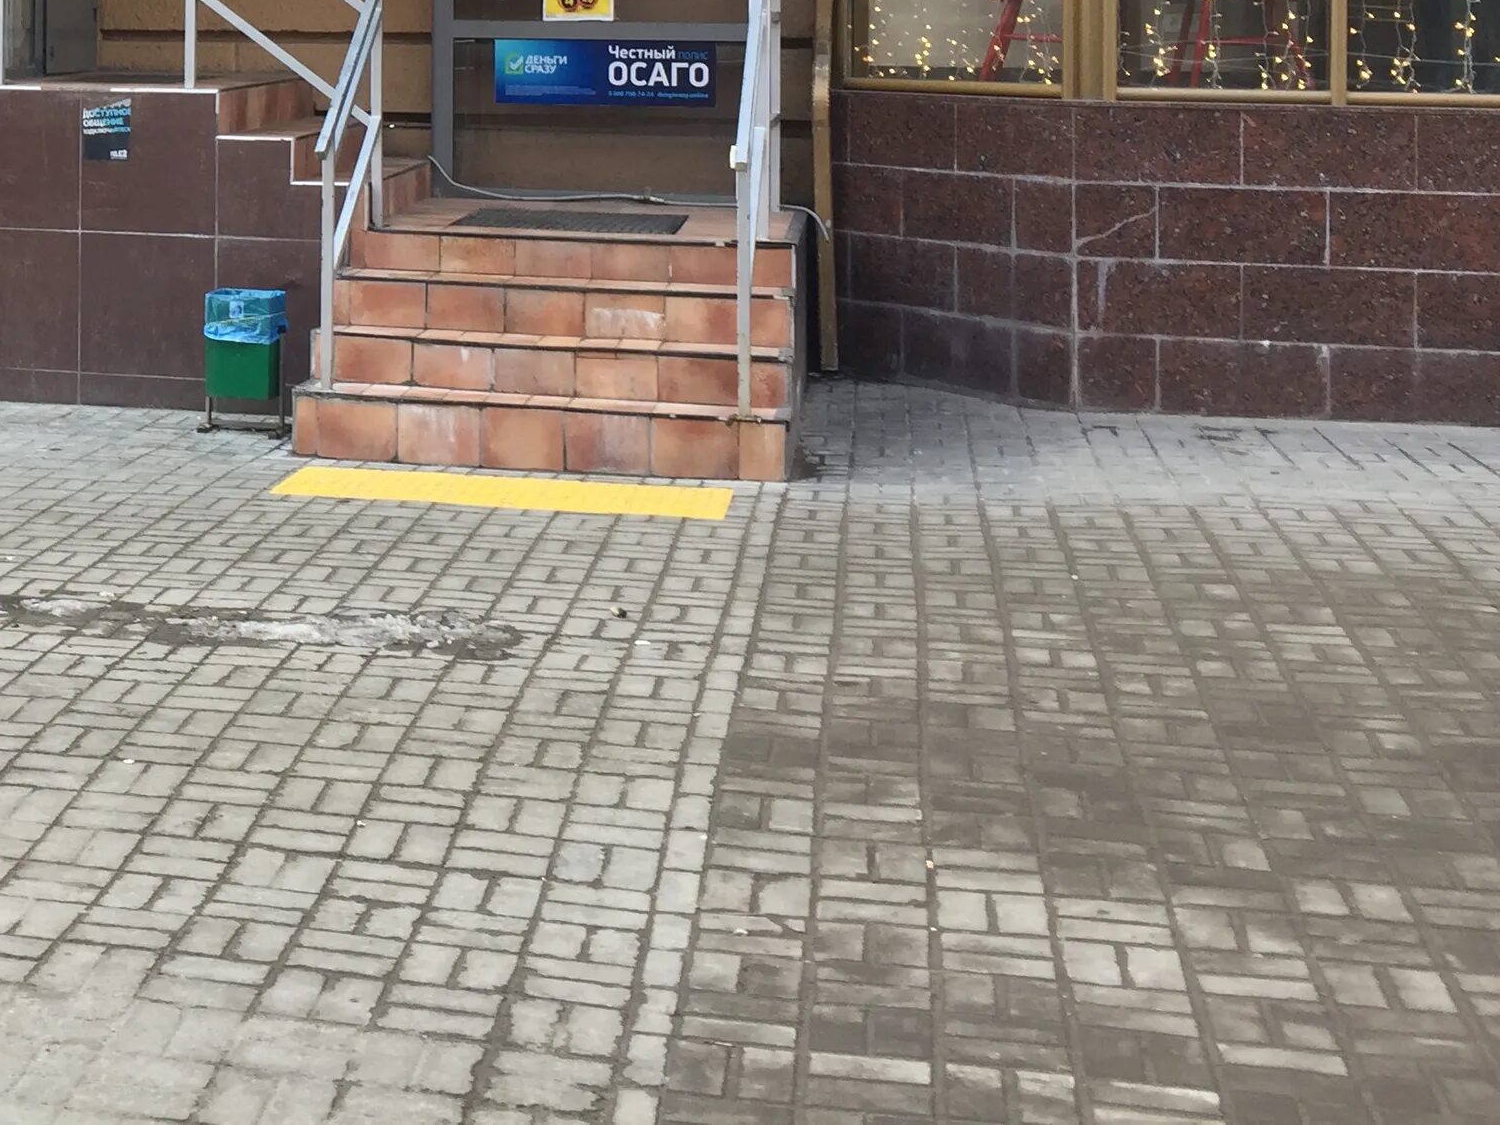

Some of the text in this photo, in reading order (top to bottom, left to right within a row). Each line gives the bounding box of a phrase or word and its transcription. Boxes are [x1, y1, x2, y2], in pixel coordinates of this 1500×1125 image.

[608, 45, 676, 60] Честный
[525, 55, 567, 65] ДЕНЬГИ
[525, 64, 557, 74] СРАЗУ
[608, 61, 709, 87] ОСАГО
